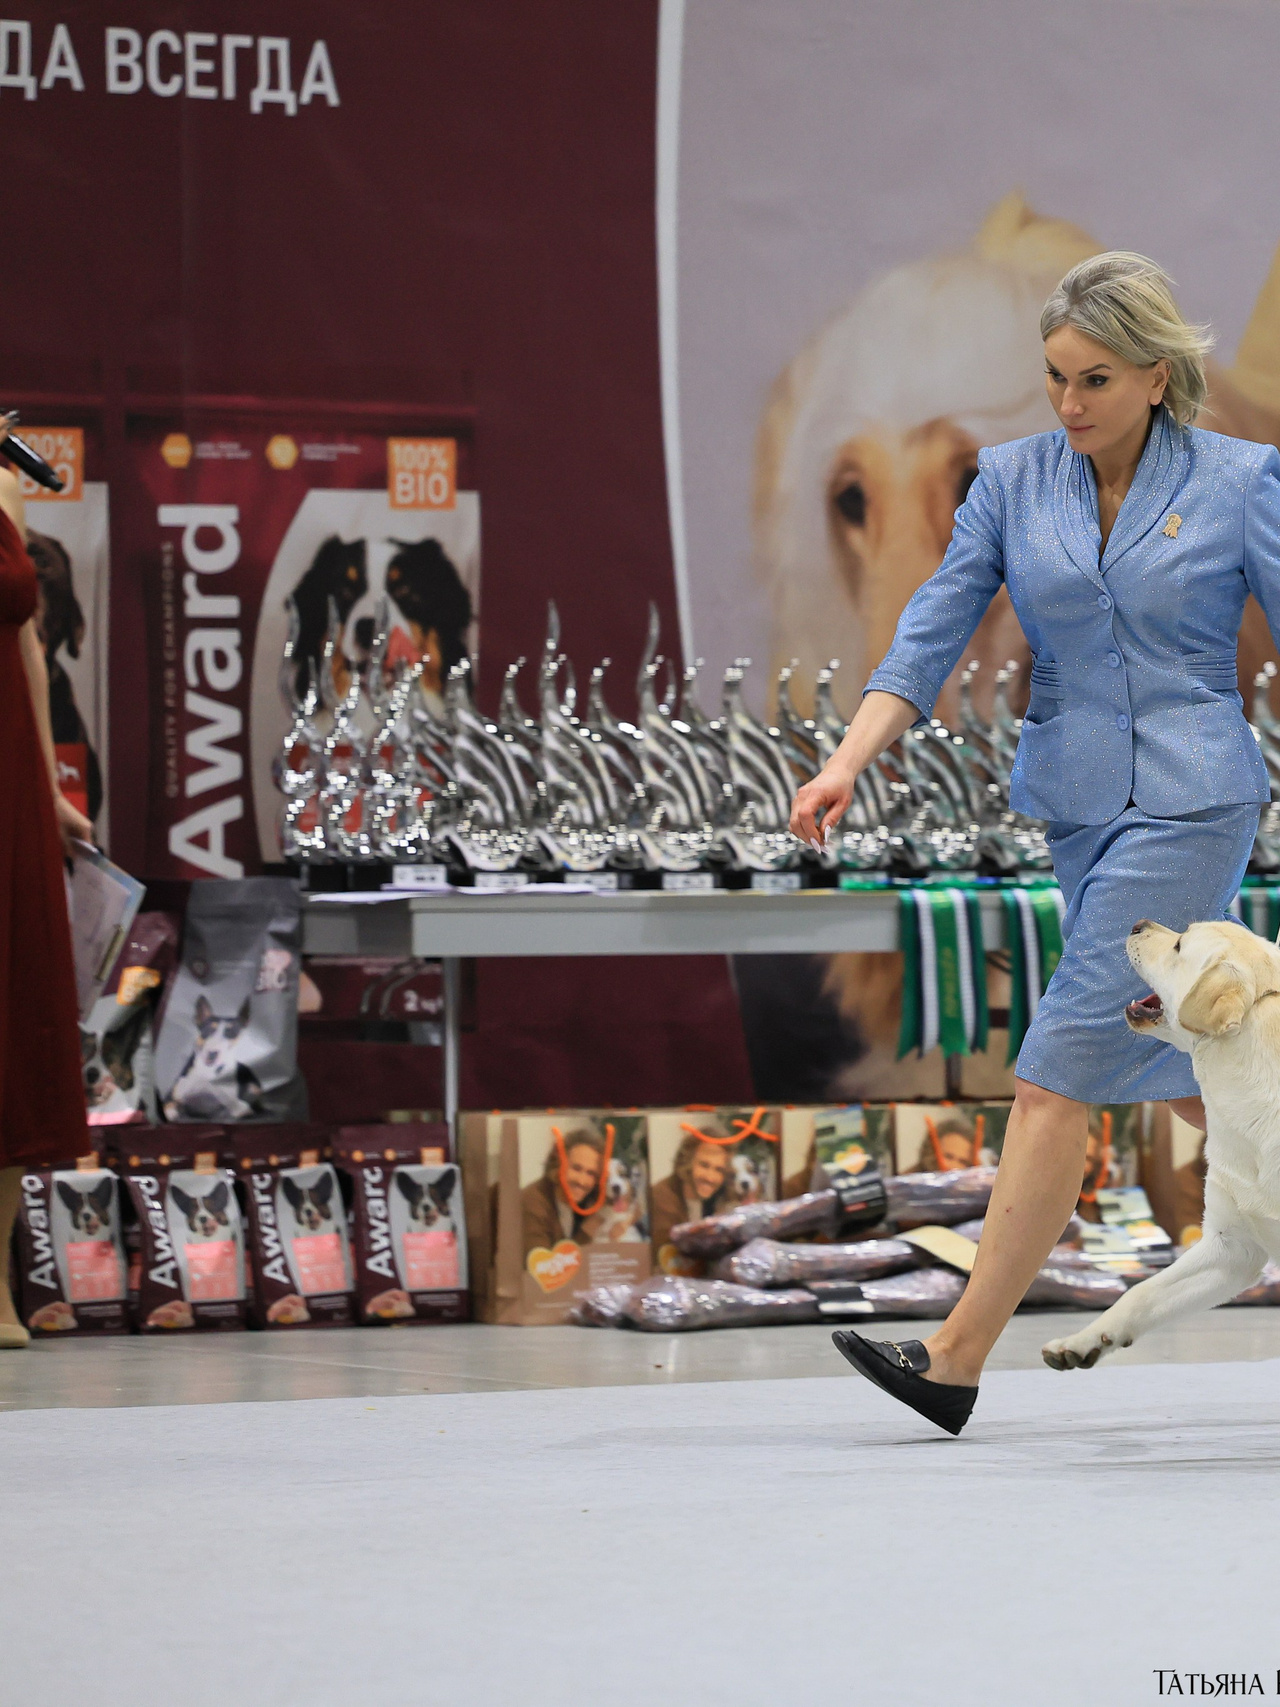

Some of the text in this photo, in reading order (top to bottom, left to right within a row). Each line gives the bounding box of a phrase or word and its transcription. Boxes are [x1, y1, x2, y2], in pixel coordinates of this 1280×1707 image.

[0, 19, 341, 117] ДА ВСЕГДА
[393, 444, 449, 470] 100%
[395, 472, 449, 505] BIO
[157, 504, 244, 879] Award
[163, 668, 177, 708] FOR
[129, 1175, 178, 1289] Award
